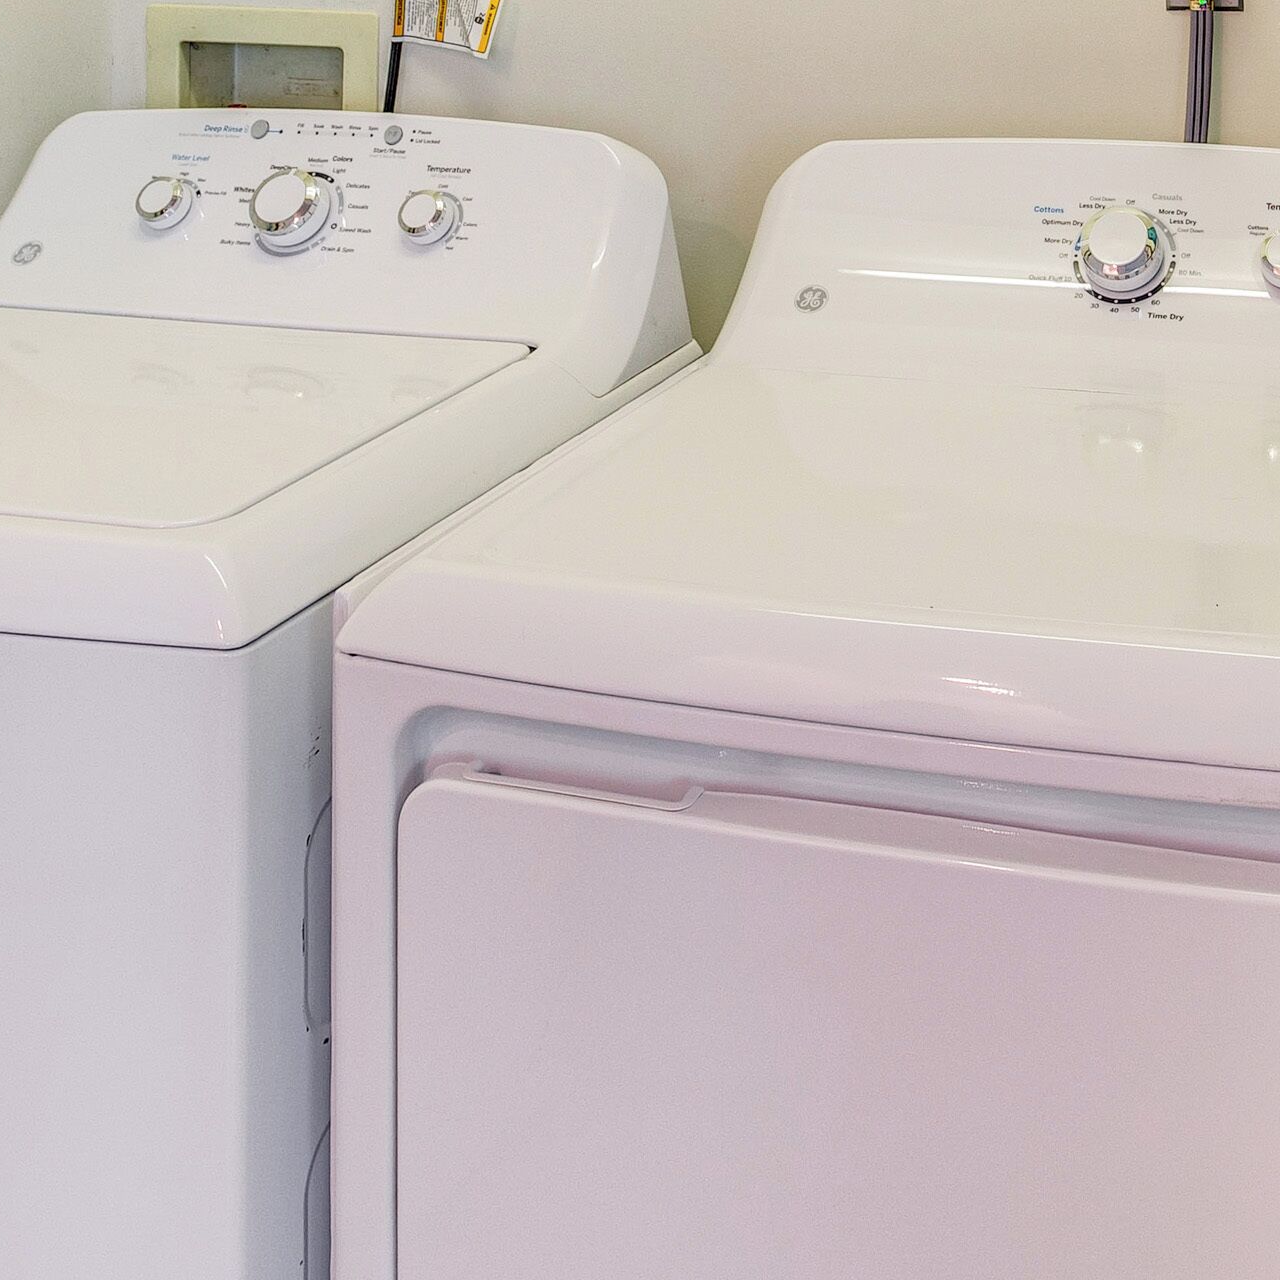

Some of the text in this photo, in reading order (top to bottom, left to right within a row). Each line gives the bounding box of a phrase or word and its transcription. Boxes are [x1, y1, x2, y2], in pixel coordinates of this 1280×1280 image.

[204, 125, 222, 133] Deep
[427, 165, 471, 174] Temperature
[1152, 193, 1183, 201] Casuals
[1034, 206, 1064, 214] Cottons
[1042, 218, 1071, 226] Optimum
[1147, 312, 1184, 322] Time Dry
